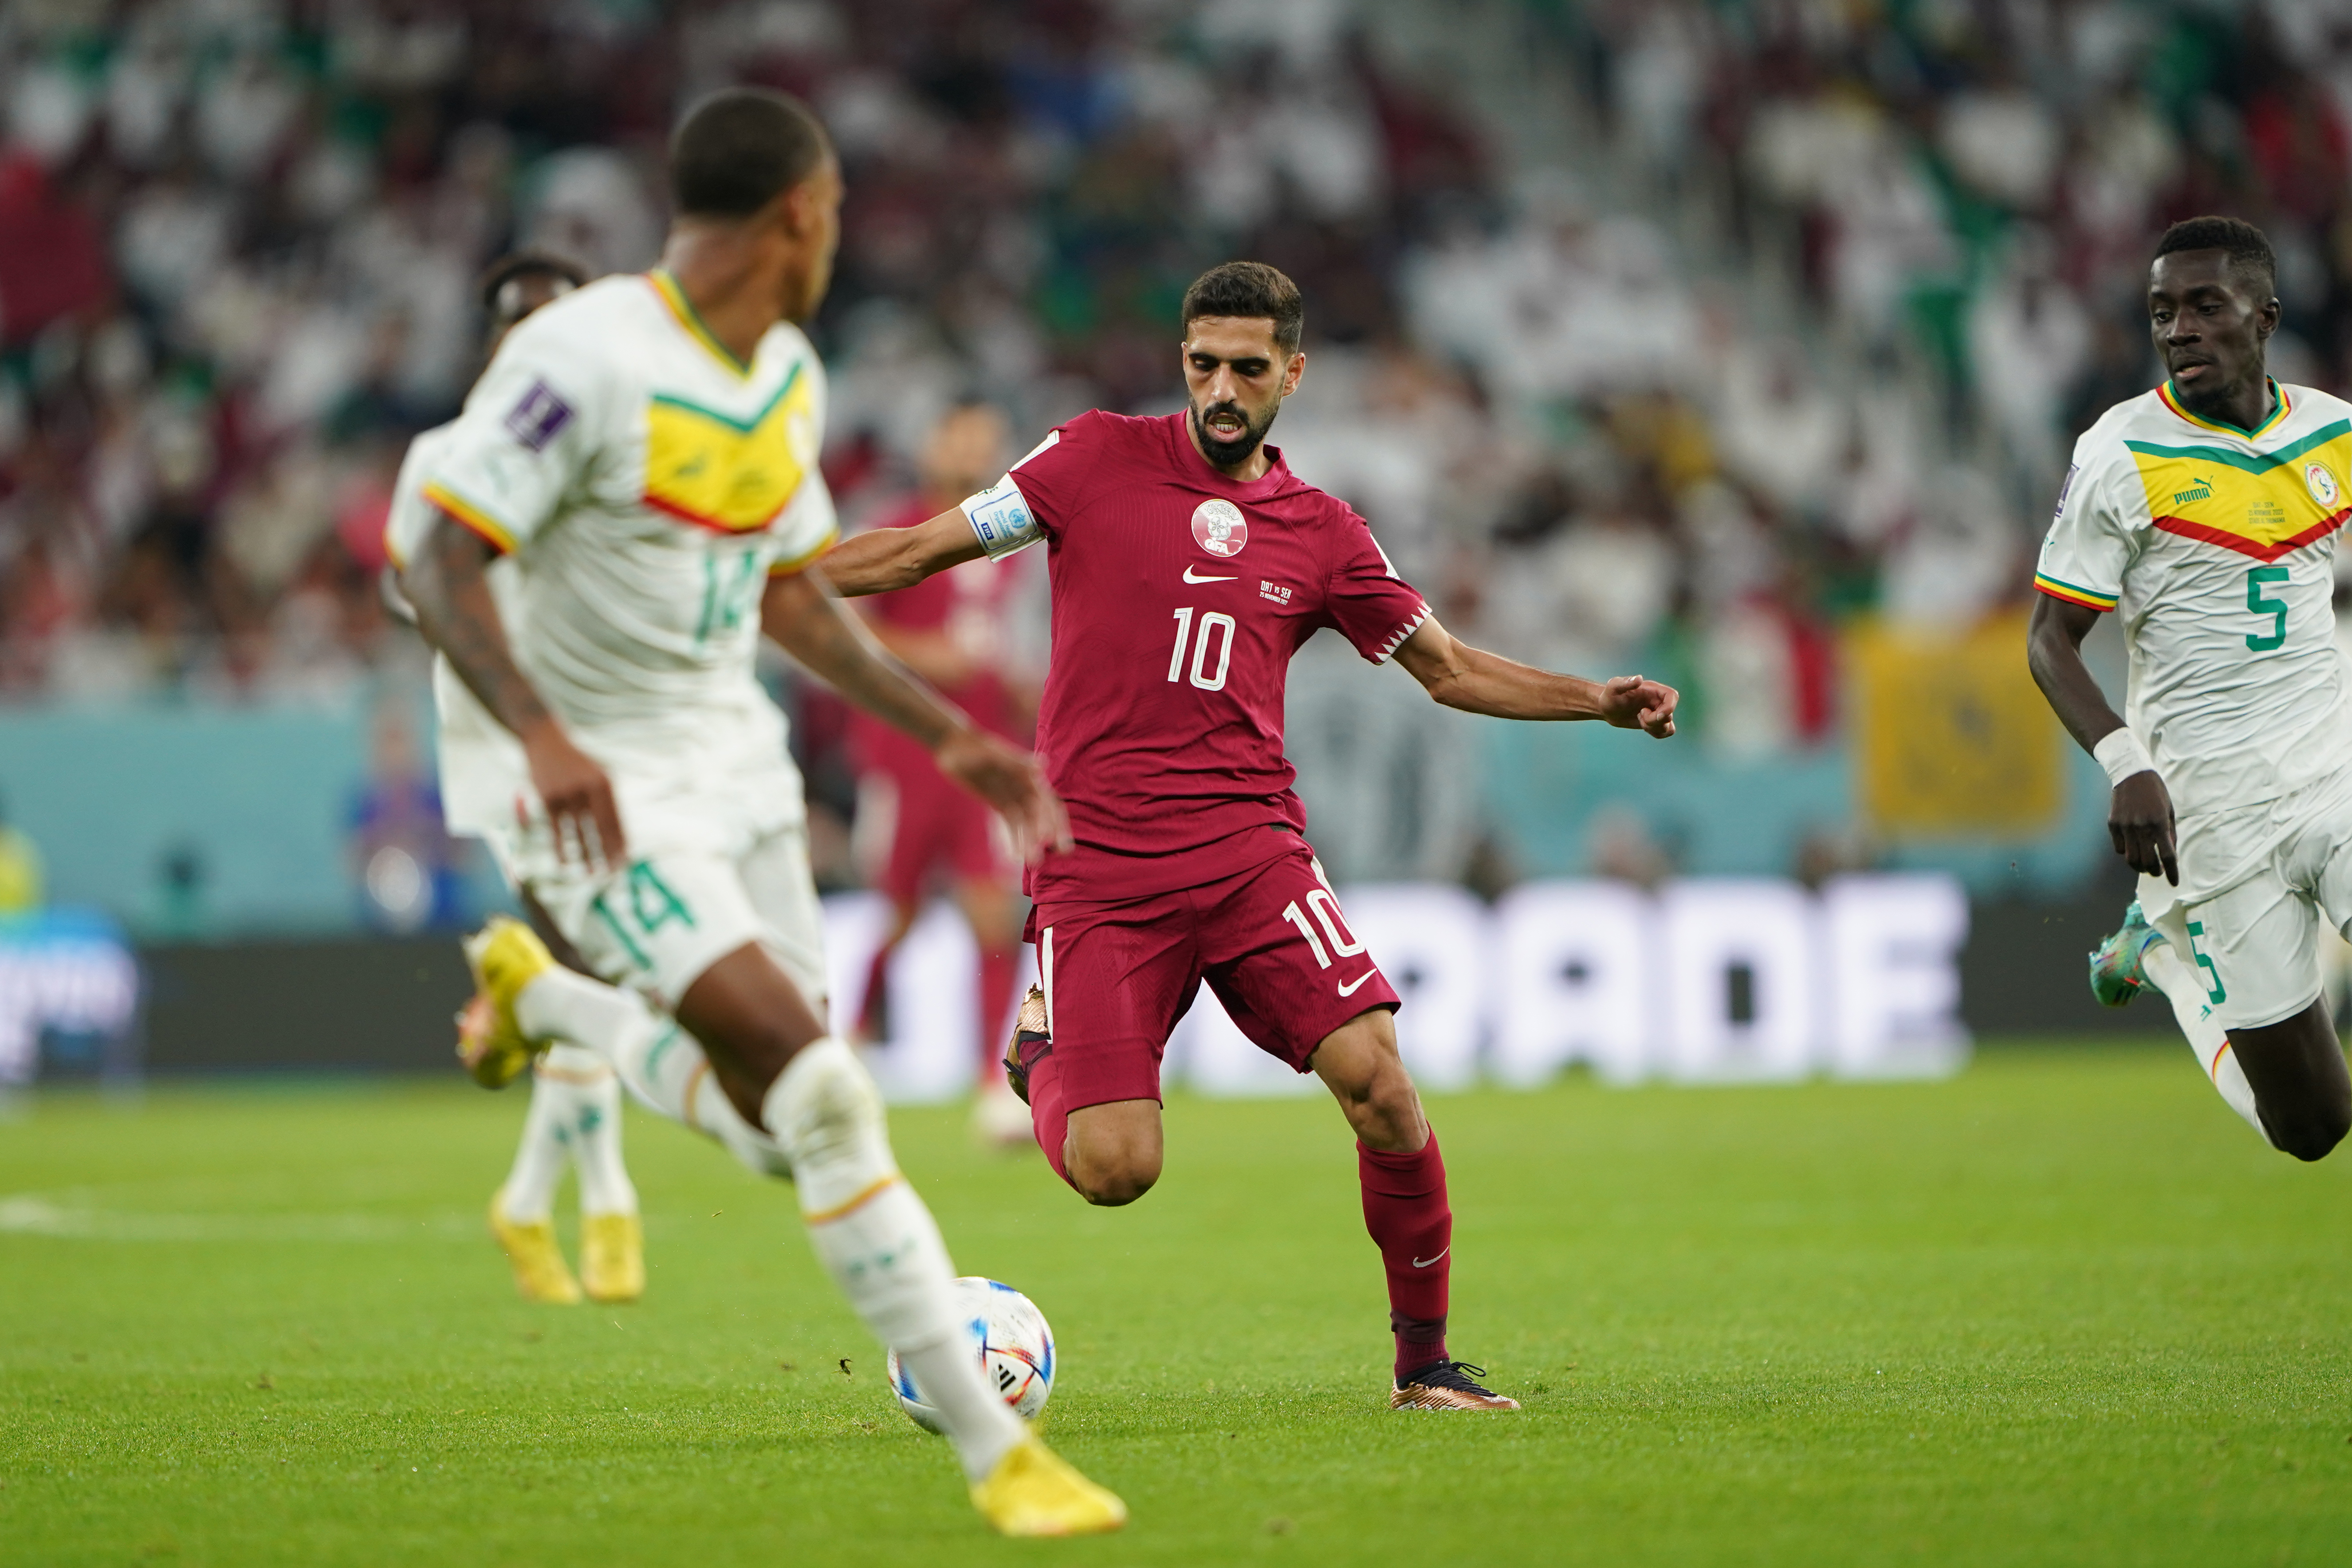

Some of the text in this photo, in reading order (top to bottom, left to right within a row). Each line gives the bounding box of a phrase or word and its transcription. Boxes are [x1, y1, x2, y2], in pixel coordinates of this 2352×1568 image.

[982, 524, 993, 539] FIFA
[999, 509, 1007, 523] World
[2174, 488, 2210, 505] PUMA
[1204, 538, 1229, 554] QFA
[693, 548, 759, 648] 14
[1261, 580, 1273, 593] QAT
[1280, 587, 1292, 599] SEN
[2246, 567, 2289, 652] 5
[1168, 607, 1235, 691] 10
[589, 860, 695, 972] 14
[1282, 889, 1365, 970] 10
[2186, 921, 2226, 1005] 5
